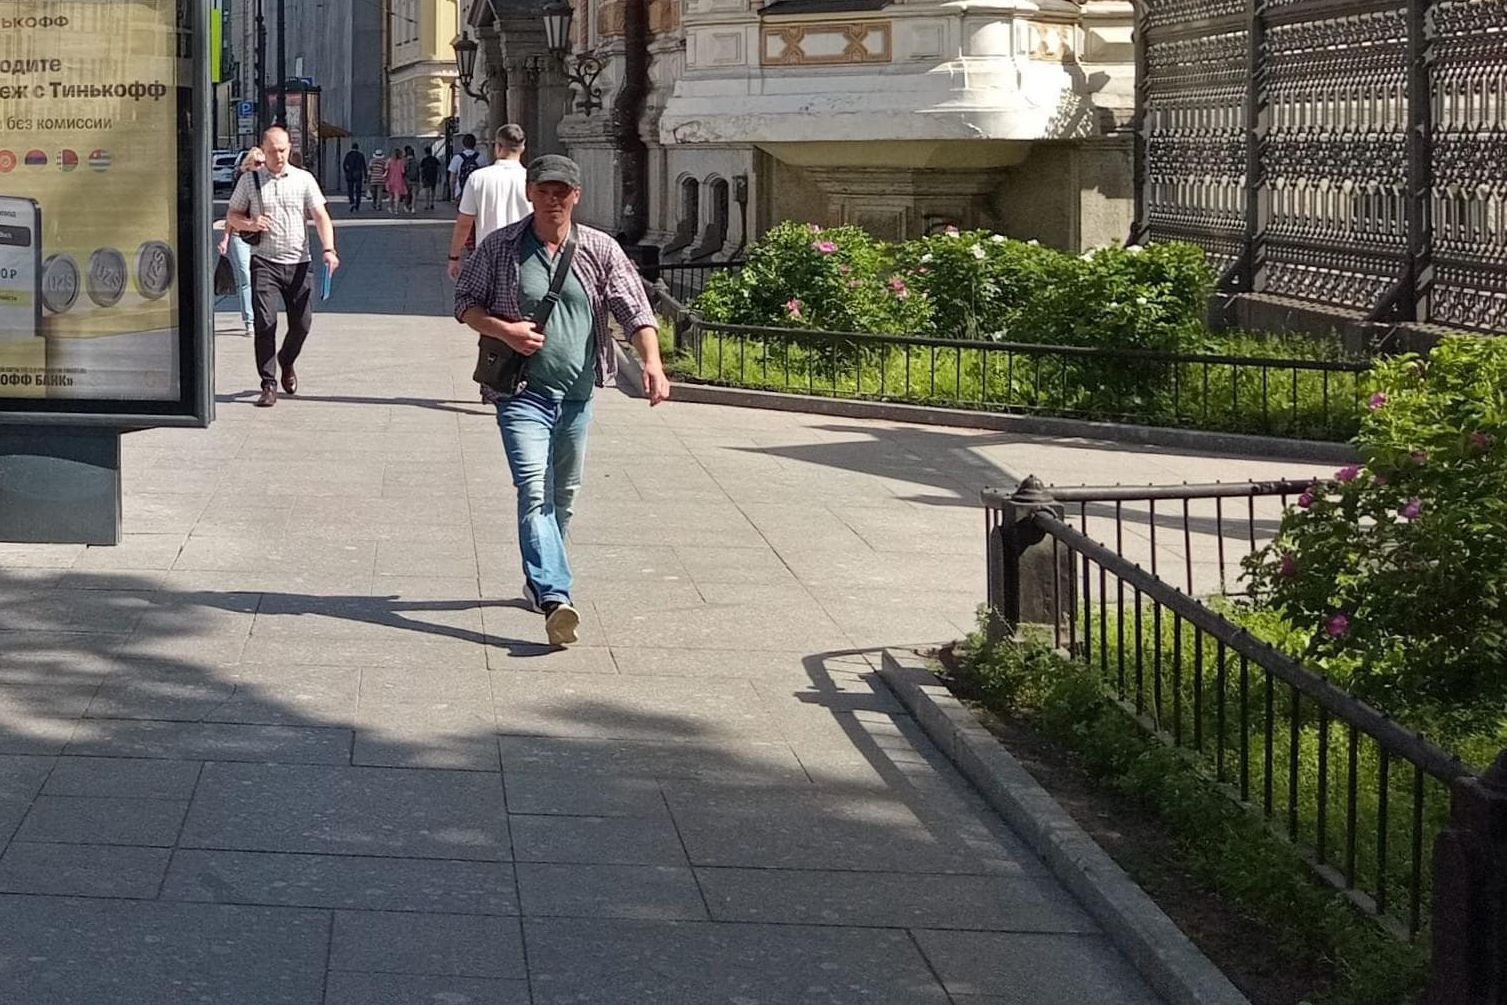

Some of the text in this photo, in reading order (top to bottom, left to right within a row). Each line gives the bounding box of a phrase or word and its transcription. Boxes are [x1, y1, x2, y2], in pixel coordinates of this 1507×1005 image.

[32, 86, 45, 98] с
[49, 79, 167, 101] Тинькофф
[7, 116, 33, 130] без
[36, 116, 113, 130] комиссии
